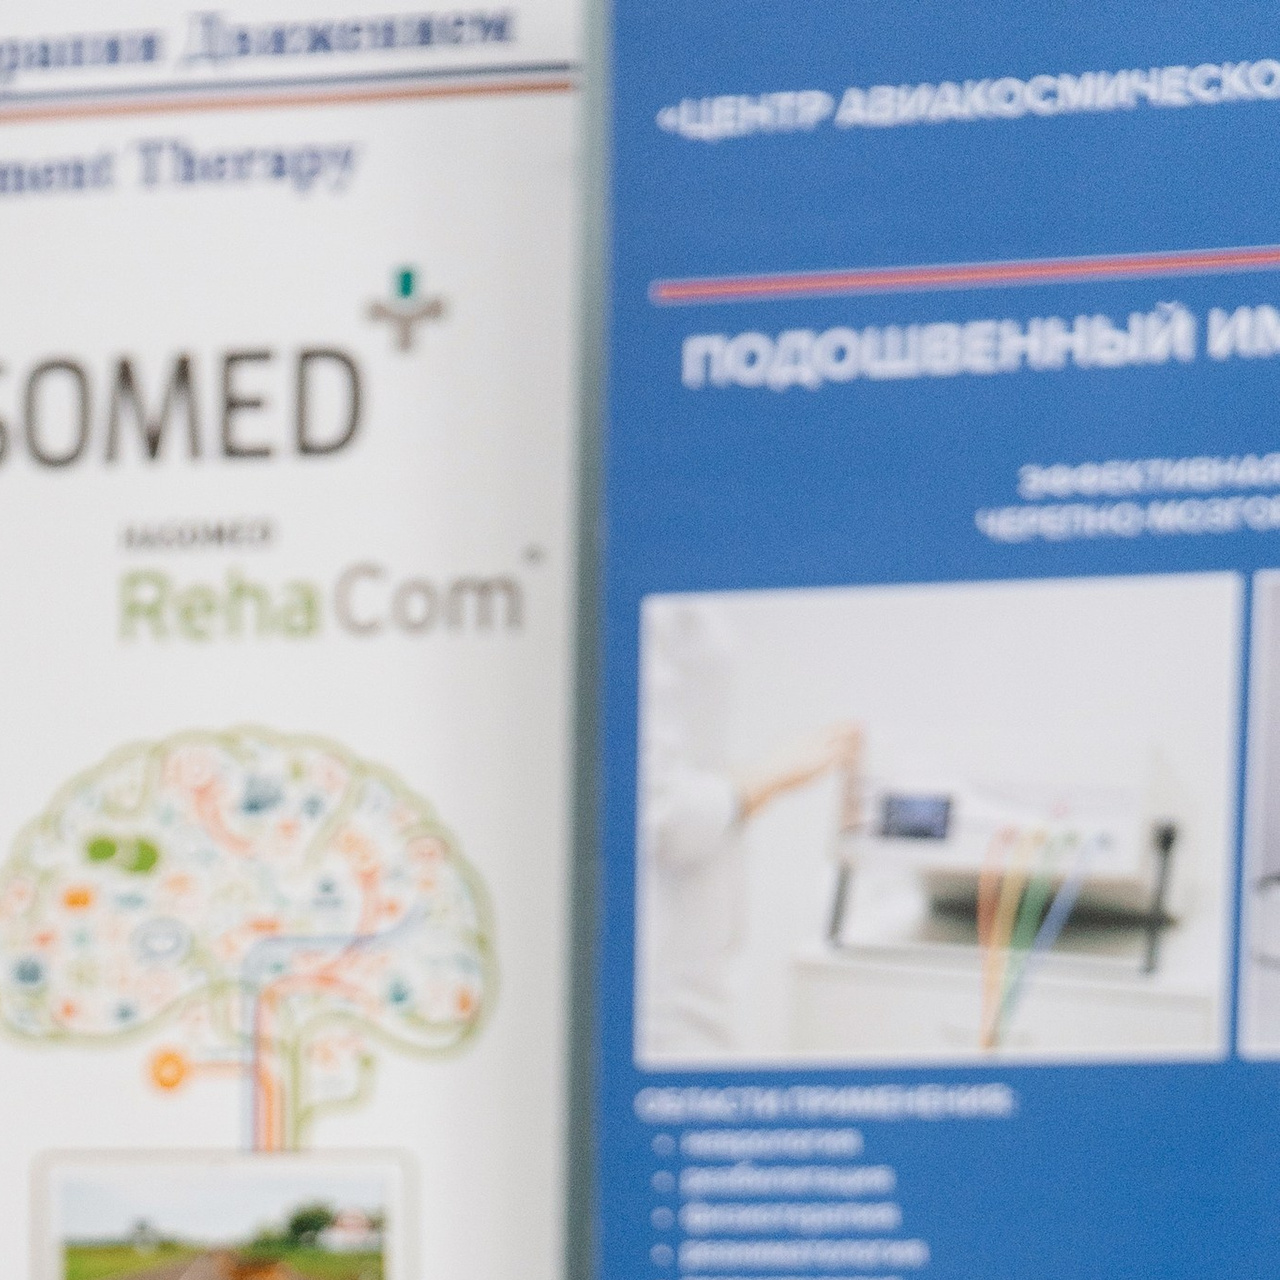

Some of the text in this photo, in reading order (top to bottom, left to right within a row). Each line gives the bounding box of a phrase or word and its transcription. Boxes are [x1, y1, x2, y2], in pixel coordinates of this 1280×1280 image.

[182, 9, 516, 70] Движением
[137, 137, 358, 191] Therapy
[682, 302, 1195, 390] ПОДОШВЕННЫЙ
